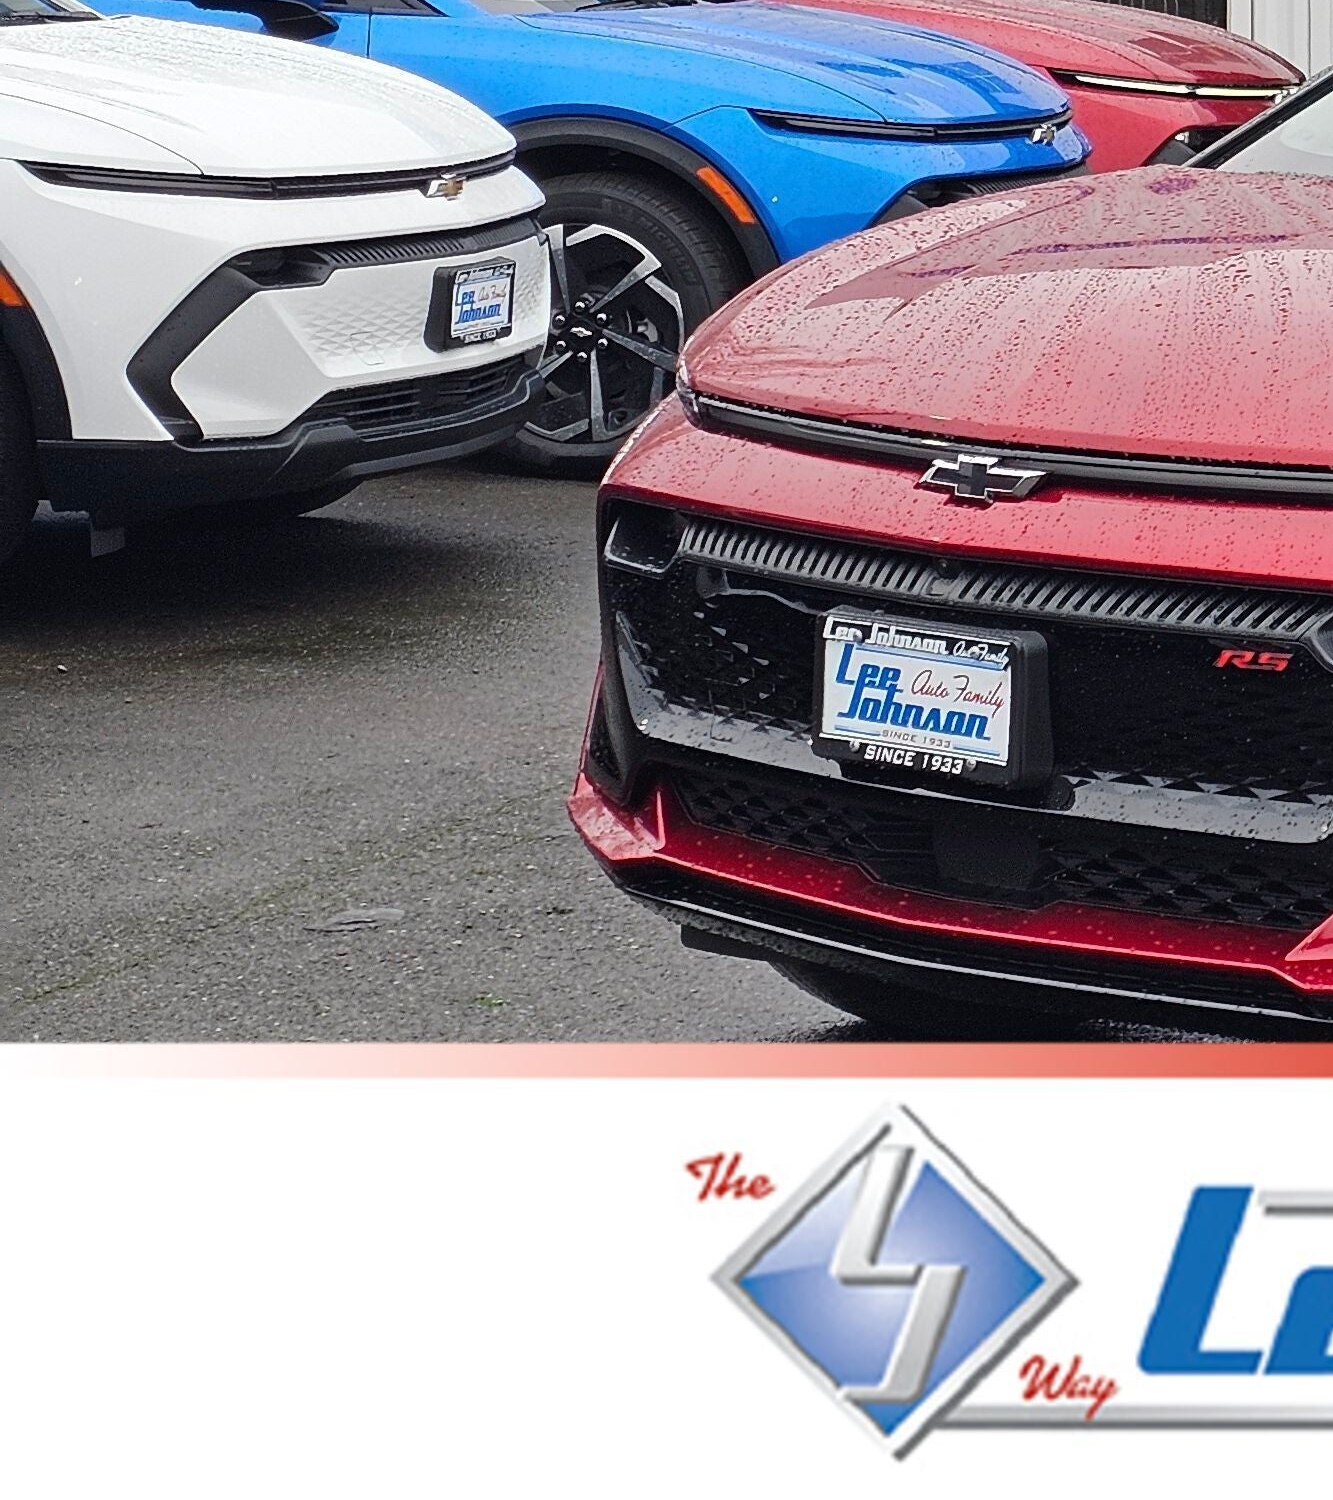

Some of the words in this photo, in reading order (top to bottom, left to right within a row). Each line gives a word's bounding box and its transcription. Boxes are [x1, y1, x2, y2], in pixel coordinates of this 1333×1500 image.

[865, 622, 949, 655] Johnson
[836, 643, 903, 693] Lee
[1212, 649, 1294, 672] RS
[911, 669, 949, 699] Auto
[953, 674, 1005, 718] Family
[837, 682, 991, 741] Johnson
[881, 729, 918, 743] SINCE
[922, 736, 951, 749] 1933
[864, 744, 915, 767] SINCE
[921, 754, 964, 775] 1933
